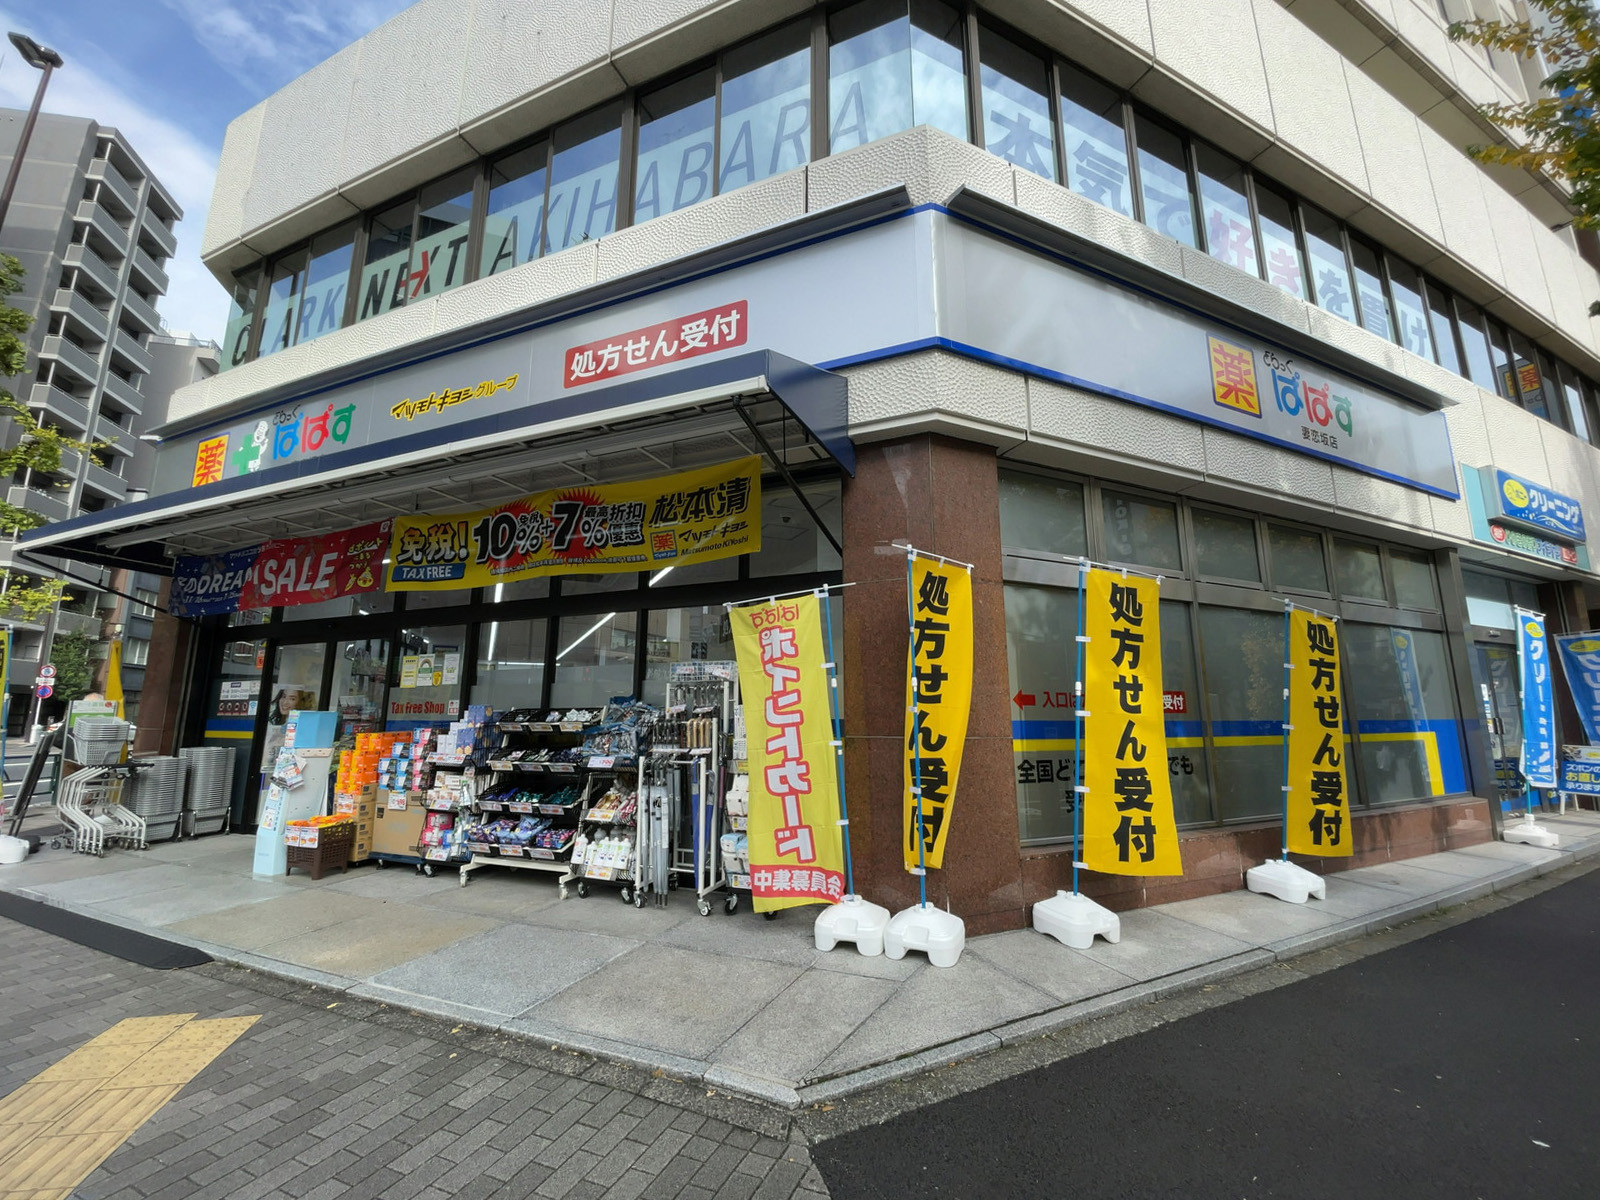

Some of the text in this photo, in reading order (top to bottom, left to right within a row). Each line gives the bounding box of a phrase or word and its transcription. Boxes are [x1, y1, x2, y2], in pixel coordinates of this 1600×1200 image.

[361, 234, 469, 320] NEXT
[491, 81, 869, 274] AKIHABARA
[569, 308, 742, 382] 処方せん受付
[389, 373, 519, 420] マツモトキヨシグループ
[1213, 344, 1255, 410] 薬
[1271, 368, 1353, 438] ぱぱす
[272, 403, 356, 460] ぱぱす
[194, 439, 227, 486] 薬
[649, 476, 751, 528] 松本清
[1529, 488, 1580, 524] クリーニング
[472, 512, 543, 565] 10%
[552, 499, 610, 551] 7%
[608, 521, 646, 547] 優惠
[652, 532, 675, 552] 薬
[678, 520, 749, 543] マツモトキヨシ
[681, 542, 722, 556] Matsumoto
[260, 551, 339, 596] SALE
[402, 565, 453, 580] TAX FREE
[391, 701, 445, 715] Tax Free Shop
[909, 570, 951, 853] 処方せん受付
[1043, 691, 1085, 708] 入口は
[1108, 582, 1157, 863] 処方せん受付
[1306, 620, 1343, 846] 処方せん受付
